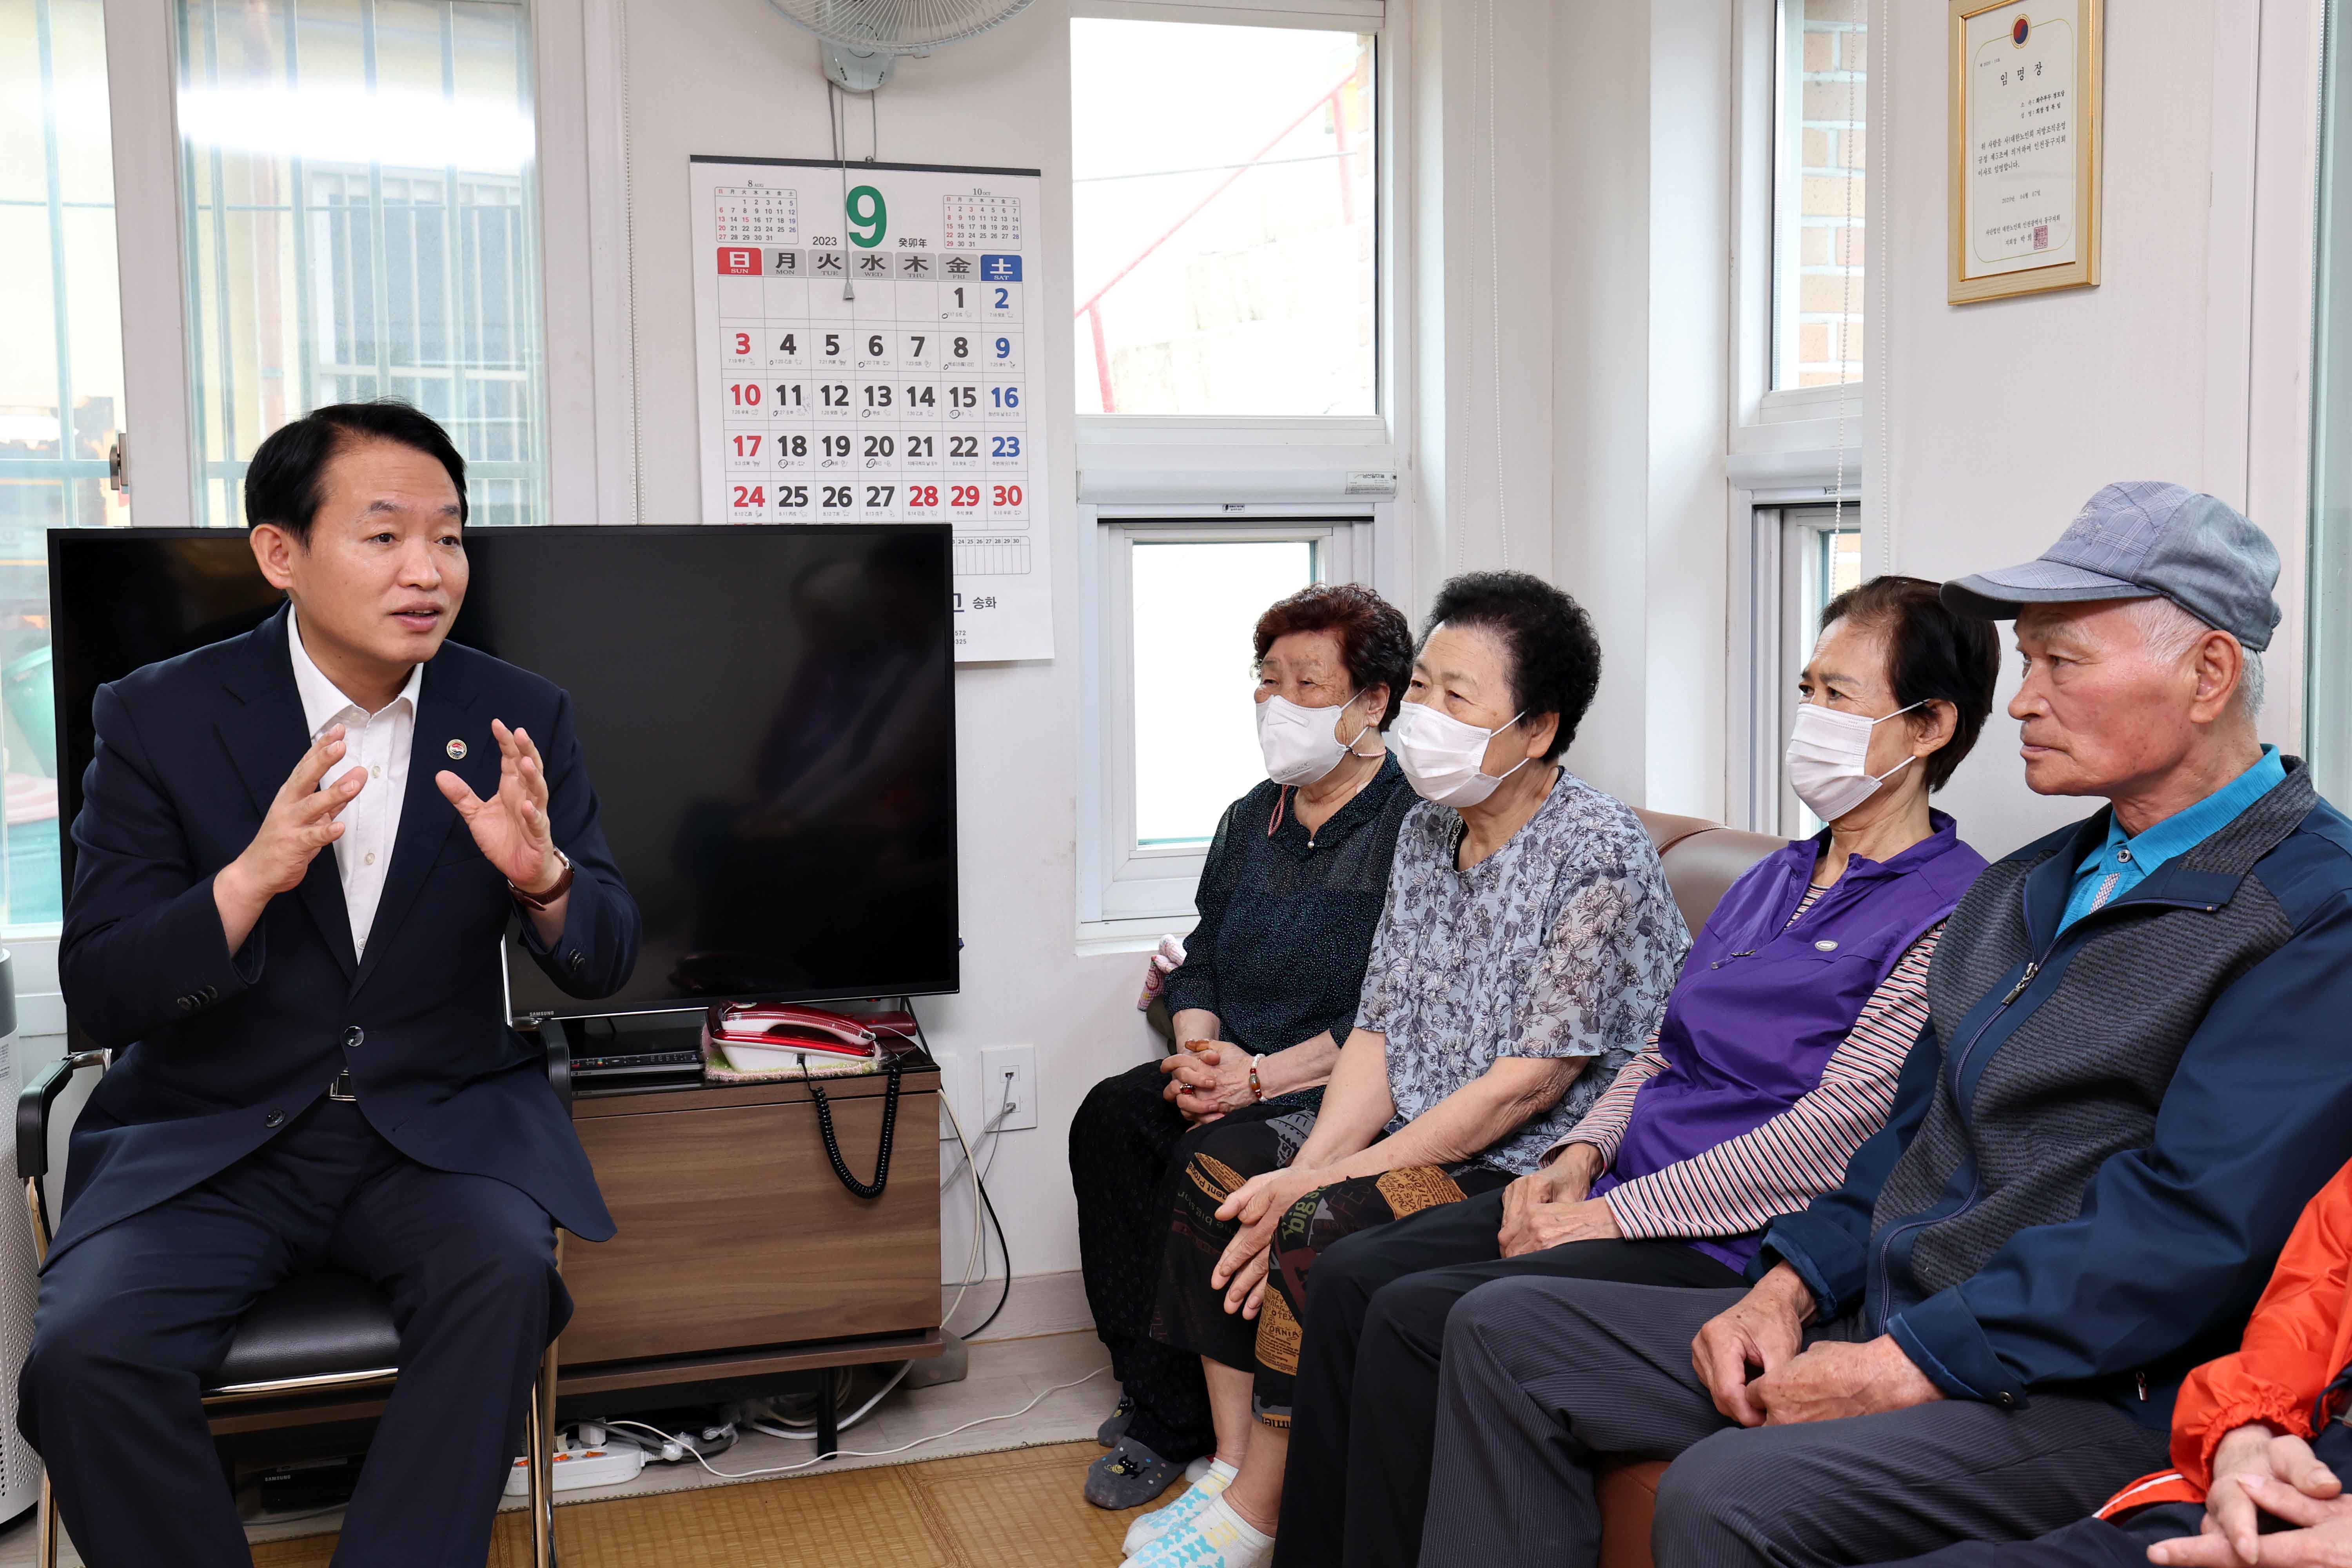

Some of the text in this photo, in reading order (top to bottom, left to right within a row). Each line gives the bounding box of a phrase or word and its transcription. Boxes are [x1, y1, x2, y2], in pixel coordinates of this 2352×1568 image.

[2001, 62, 2042, 86] 임 명 장
[2011, 143, 2031, 155] 의거하여
[1978, 160, 2020, 177] 이사로 임명합니다.
[847, 185, 887, 248] 9
[813, 236, 927, 248] 2023 癸卯年
[729, 252, 1013, 274] 日 月 火 水 木 金 土
[954, 288, 1009, 309] 1 2
[736, 333, 1010, 358] 3 4 5 6 7 8 9
[731, 384, 1018, 408] 10 11 12 13 14 15 16
[733, 436, 1020, 457] 17 18 19 20 21 22 23
[734, 485, 1022, 507] 24 25 26 27 28 29 30
[973, 597, 997, 609] 송화
